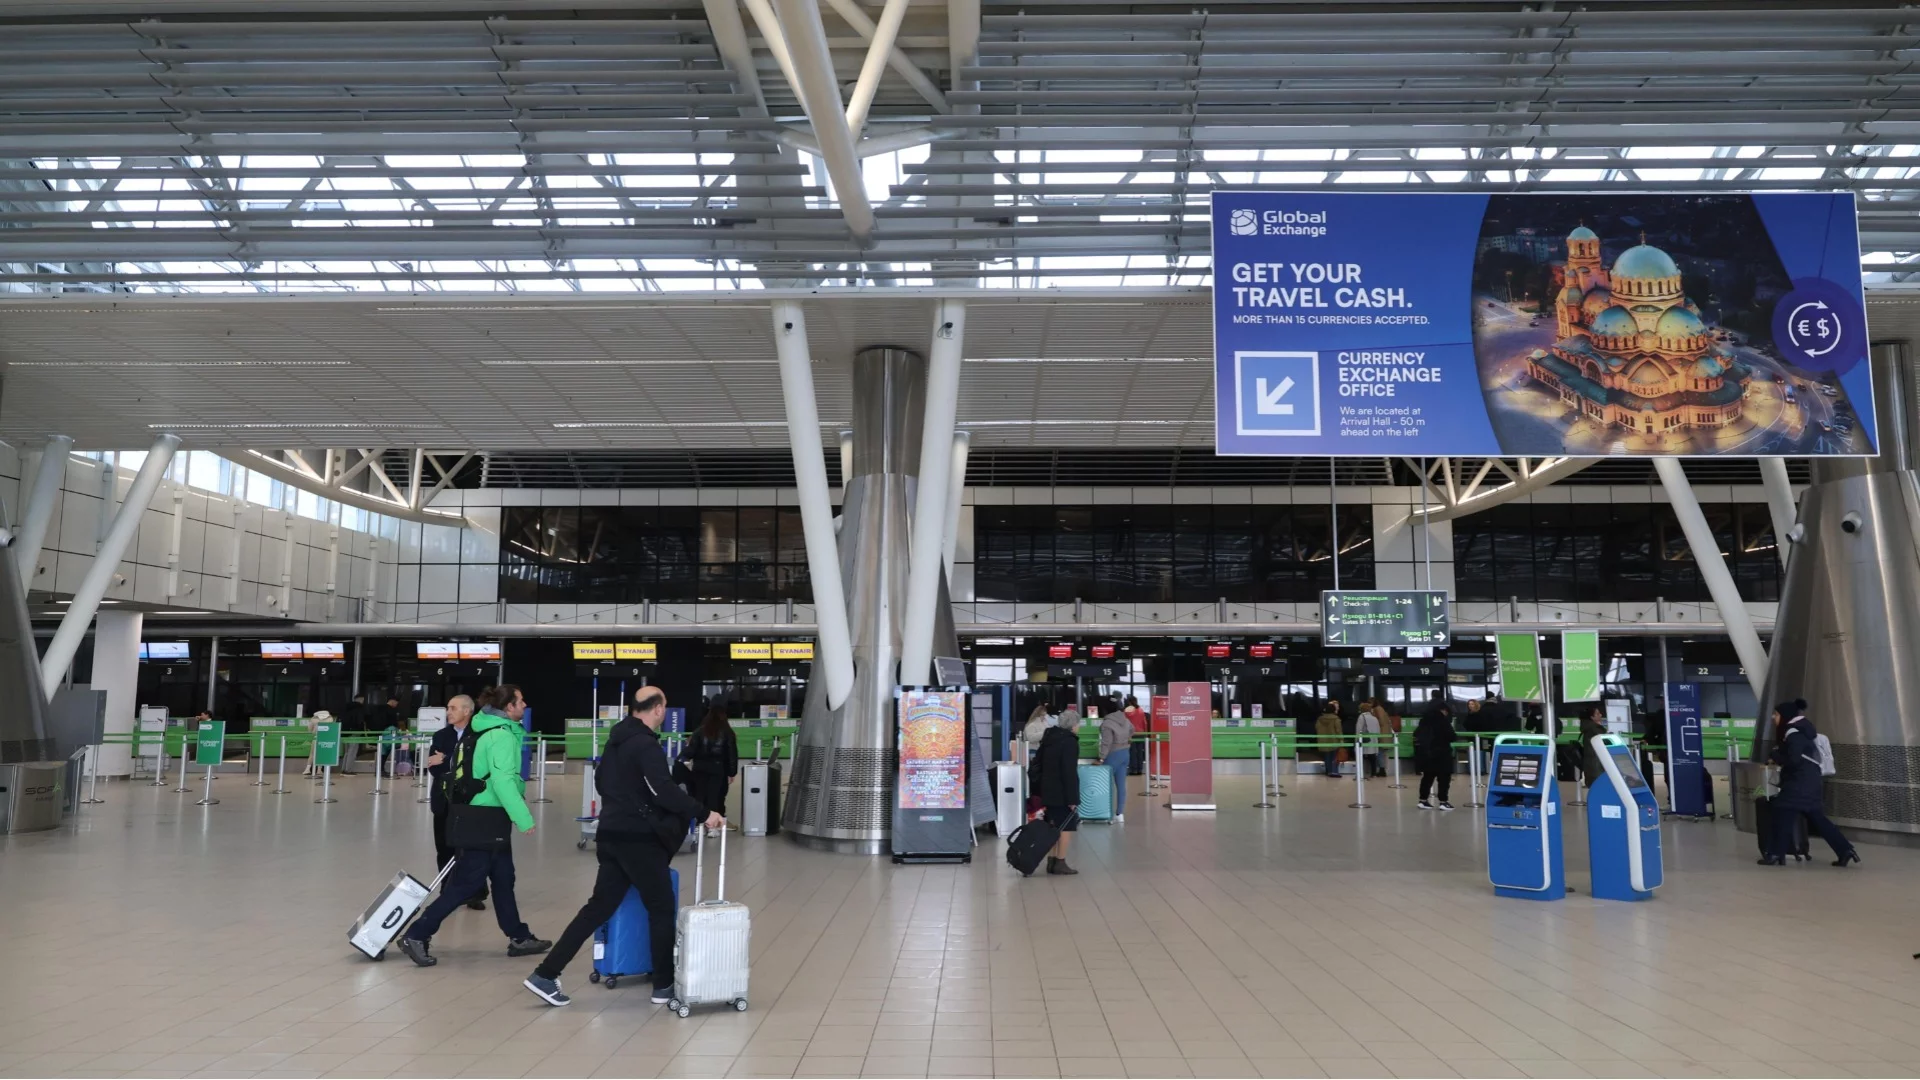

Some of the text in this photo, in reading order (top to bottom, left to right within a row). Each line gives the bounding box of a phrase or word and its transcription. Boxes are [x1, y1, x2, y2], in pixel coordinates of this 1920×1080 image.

[1263, 210, 1326, 223] Global
[1263, 224, 1326, 237] Exchange
[1232, 262, 1362, 283] GET YOUR
[1232, 287, 1413, 308] TRAVEL CASH.
[1233, 315, 1430, 325] MORE THAN 15 CURRENCIES ACCEPTED.
[1338, 352, 1425, 365] CURRENCY
[1339, 367, 1442, 382] EXCHANGE
[1338, 384, 1396, 397] OFFICE
[1340, 406, 1356, 415] We
[1375, 406, 1410, 415] located
[1412, 407, 1421, 415] at
[1340, 417, 1370, 426] Arrival
[1372, 417, 1390, 426] Hall
[1400, 417, 1413, 426] 50
[1341, 428, 1369, 436] ahead
[1387, 428, 1401, 436] the
[1404, 428, 1418, 436] left
